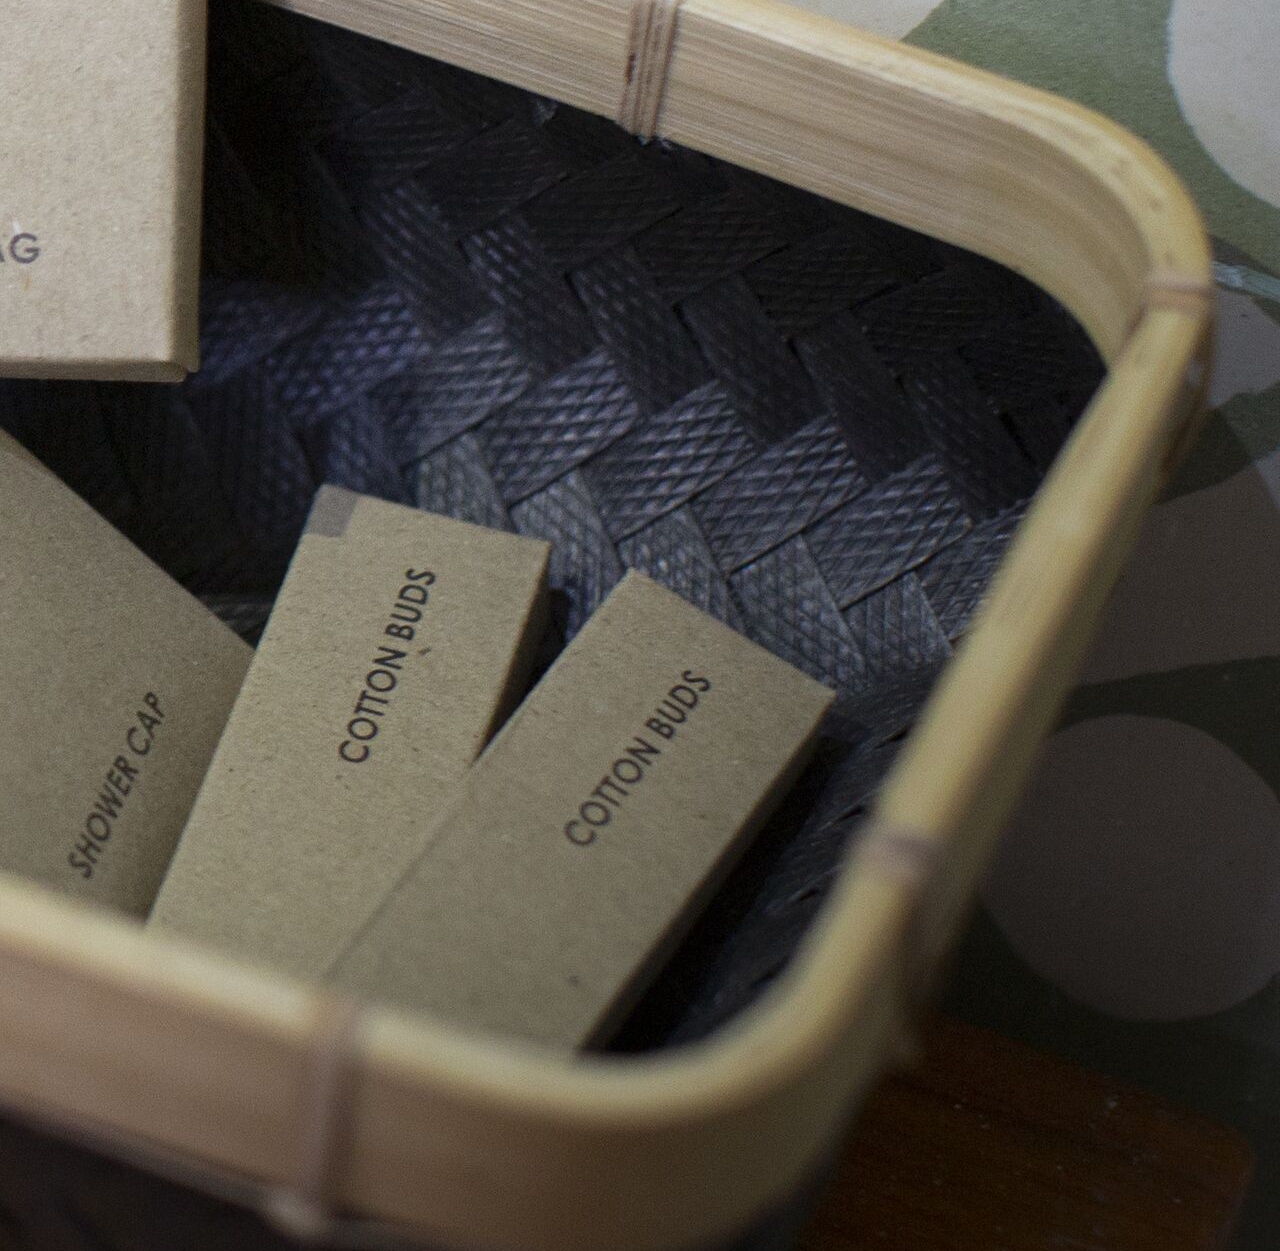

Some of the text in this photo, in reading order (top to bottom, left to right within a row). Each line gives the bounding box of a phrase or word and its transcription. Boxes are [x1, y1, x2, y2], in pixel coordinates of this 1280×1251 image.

[338, 568, 437, 764] COTTON BUDS
[564, 669, 712, 847] COTTON BUDS
[68, 691, 165, 879] SHOWER CAP
